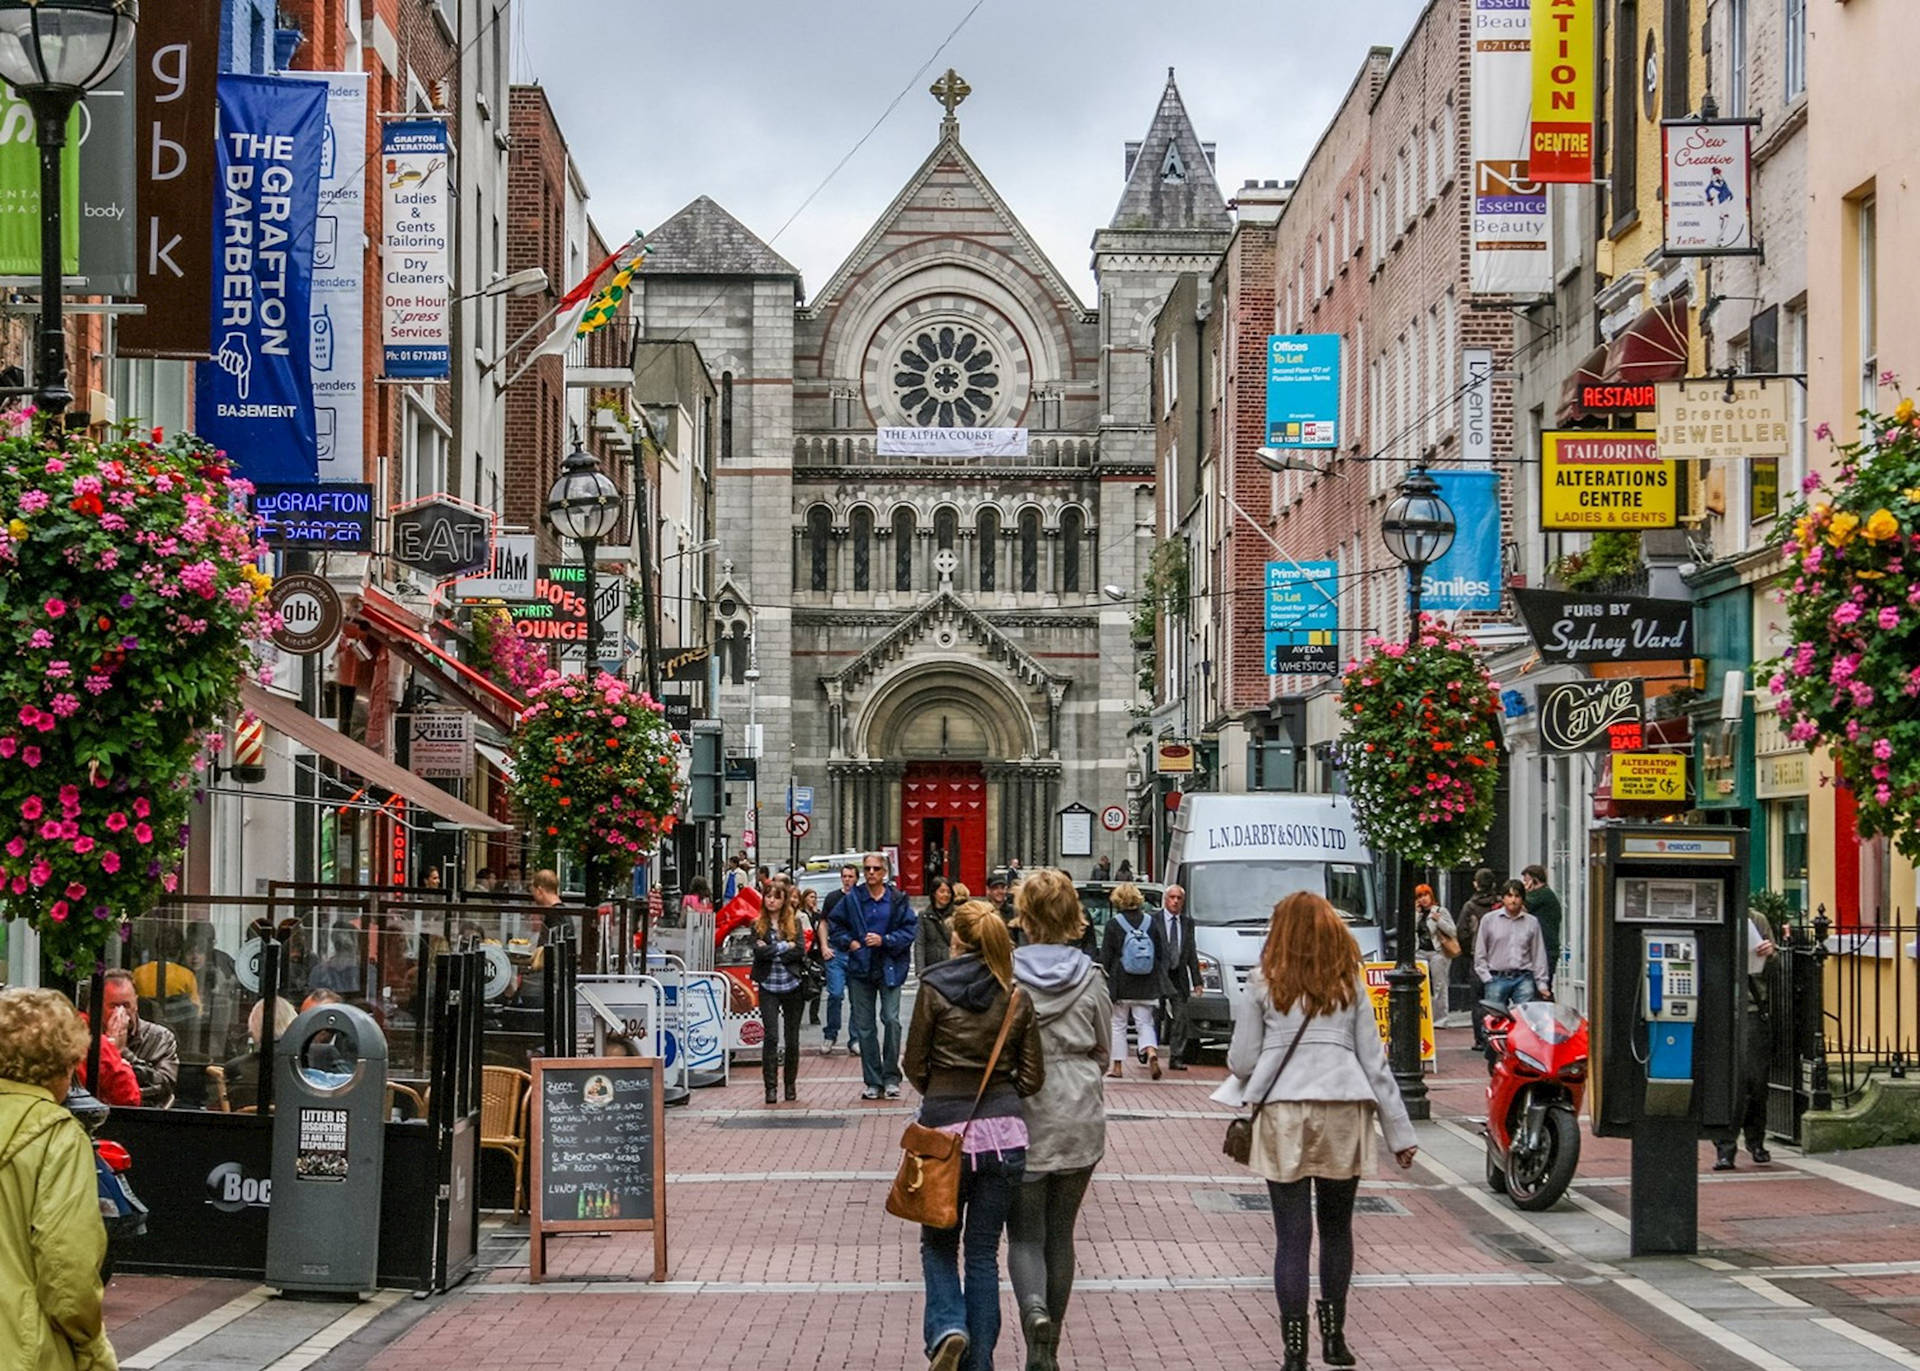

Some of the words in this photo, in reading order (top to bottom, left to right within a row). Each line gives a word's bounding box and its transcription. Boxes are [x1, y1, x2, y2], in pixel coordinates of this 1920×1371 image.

[1483, 41, 1530, 50] 67164
[393, 135, 436, 143] GRAFTON
[1534, 132, 1588, 152] CENTRE
[1686, 126, 1726, 150] Sew
[230, 133, 294, 160] THE
[385, 143, 445, 152] ALTERATIONS
[1674, 147, 1734, 167] Creative
[395, 193, 437, 204] Ladies
[84, 202, 125, 221] body
[1476, 198, 1546, 213] Essence
[411, 207, 421, 218] &
[396, 221, 435, 233] Gents
[1474, 219, 1544, 235] Beauty
[222, 165, 253, 326] BARBER
[387, 235, 445, 249] Tailoring
[260, 166, 293, 355] GRAFTON
[404, 258, 428, 272] Dry
[387, 272, 445, 284] Cleaners
[385, 296, 412, 307] One
[415, 296, 446, 307] Hour
[391, 327, 442, 338] Services
[1273, 341, 1308, 352] Offices
[401, 351, 411, 361] 01
[412, 351, 447, 361] 6717813
[1274, 353, 1285, 363] To
[1287, 353, 1304, 363] Let
[1686, 389, 1759, 402] Loran
[217, 404, 296, 417] BASEMENT
[1676, 407, 1771, 421] Brereton
[884, 430, 906, 440] THE
[909, 430, 946, 440] ALPHA
[949, 430, 993, 440] COURSE
[1660, 423, 1787, 444] JEWELLER
[1564, 443, 1657, 460] TAILORING
[1555, 470, 1668, 487] ALTERATIONS
[277, 492, 368, 513] GRAFTON
[1579, 491, 1643, 507] CENTRE
[1555, 512, 1601, 523] LADIES
[1607, 513, 1616, 523] &
[1621, 512, 1667, 523] GENTS
[398, 517, 482, 563] EAT
[1420, 576, 1490, 596] Smiles
[1272, 592, 1283, 602] To
[1285, 592, 1301, 602] Let
[283, 600, 319, 624] gbk
[1564, 605, 1603, 617] FURS
[1610, 604, 1630, 616] BY
[1544, 620, 1626, 659] Sydney
[1631, 619, 1687, 649] Vard
[1292, 646, 1323, 654] AVEDA
[1280, 661, 1336, 672] WHETSTONE
[1610, 736, 1642, 750] BAR
[1621, 759, 1677, 767] ALTERATION
[1108, 812, 1121, 822] 50
[1321, 827, 1346, 850] LTD
[302, 1110, 334, 1121] LITTER
[336, 1111, 347, 1122] IS
